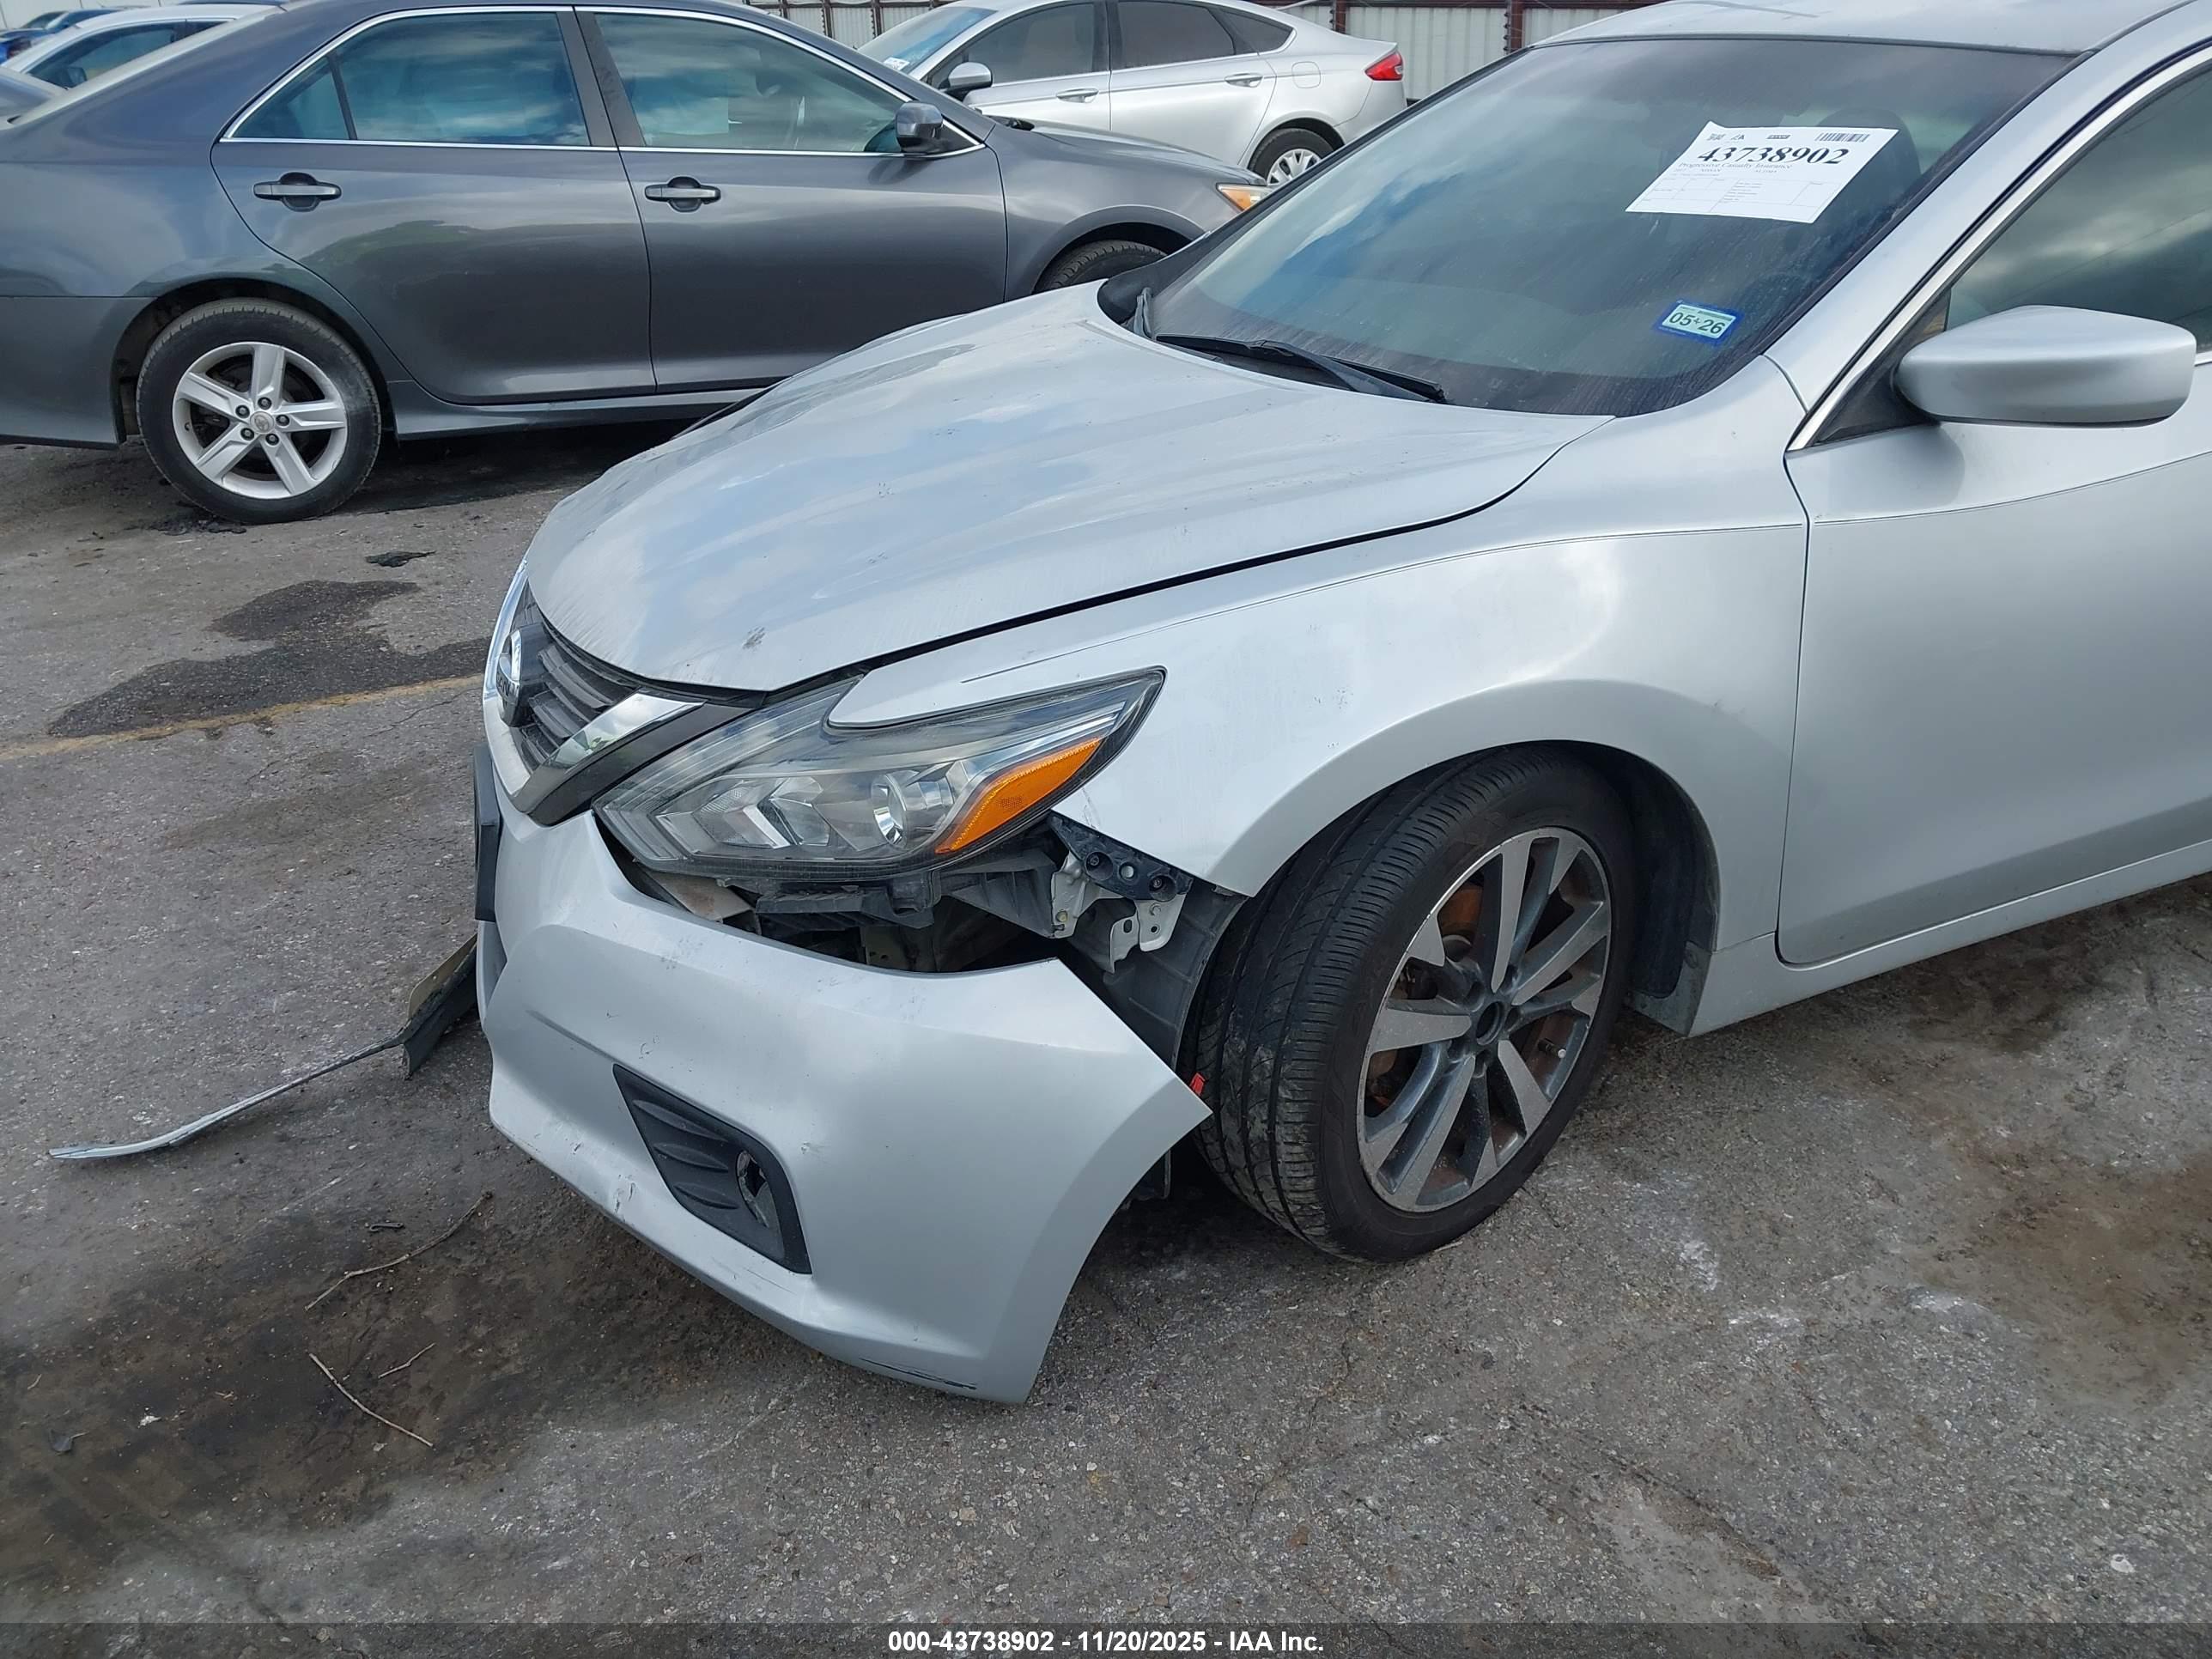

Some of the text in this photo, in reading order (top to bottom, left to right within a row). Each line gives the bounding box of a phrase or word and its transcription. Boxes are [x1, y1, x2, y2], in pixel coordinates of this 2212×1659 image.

[1698, 147, 1850, 165] 43738902
[1669, 312, 1696, 326] 05
[1697, 319, 1726, 334] 26
